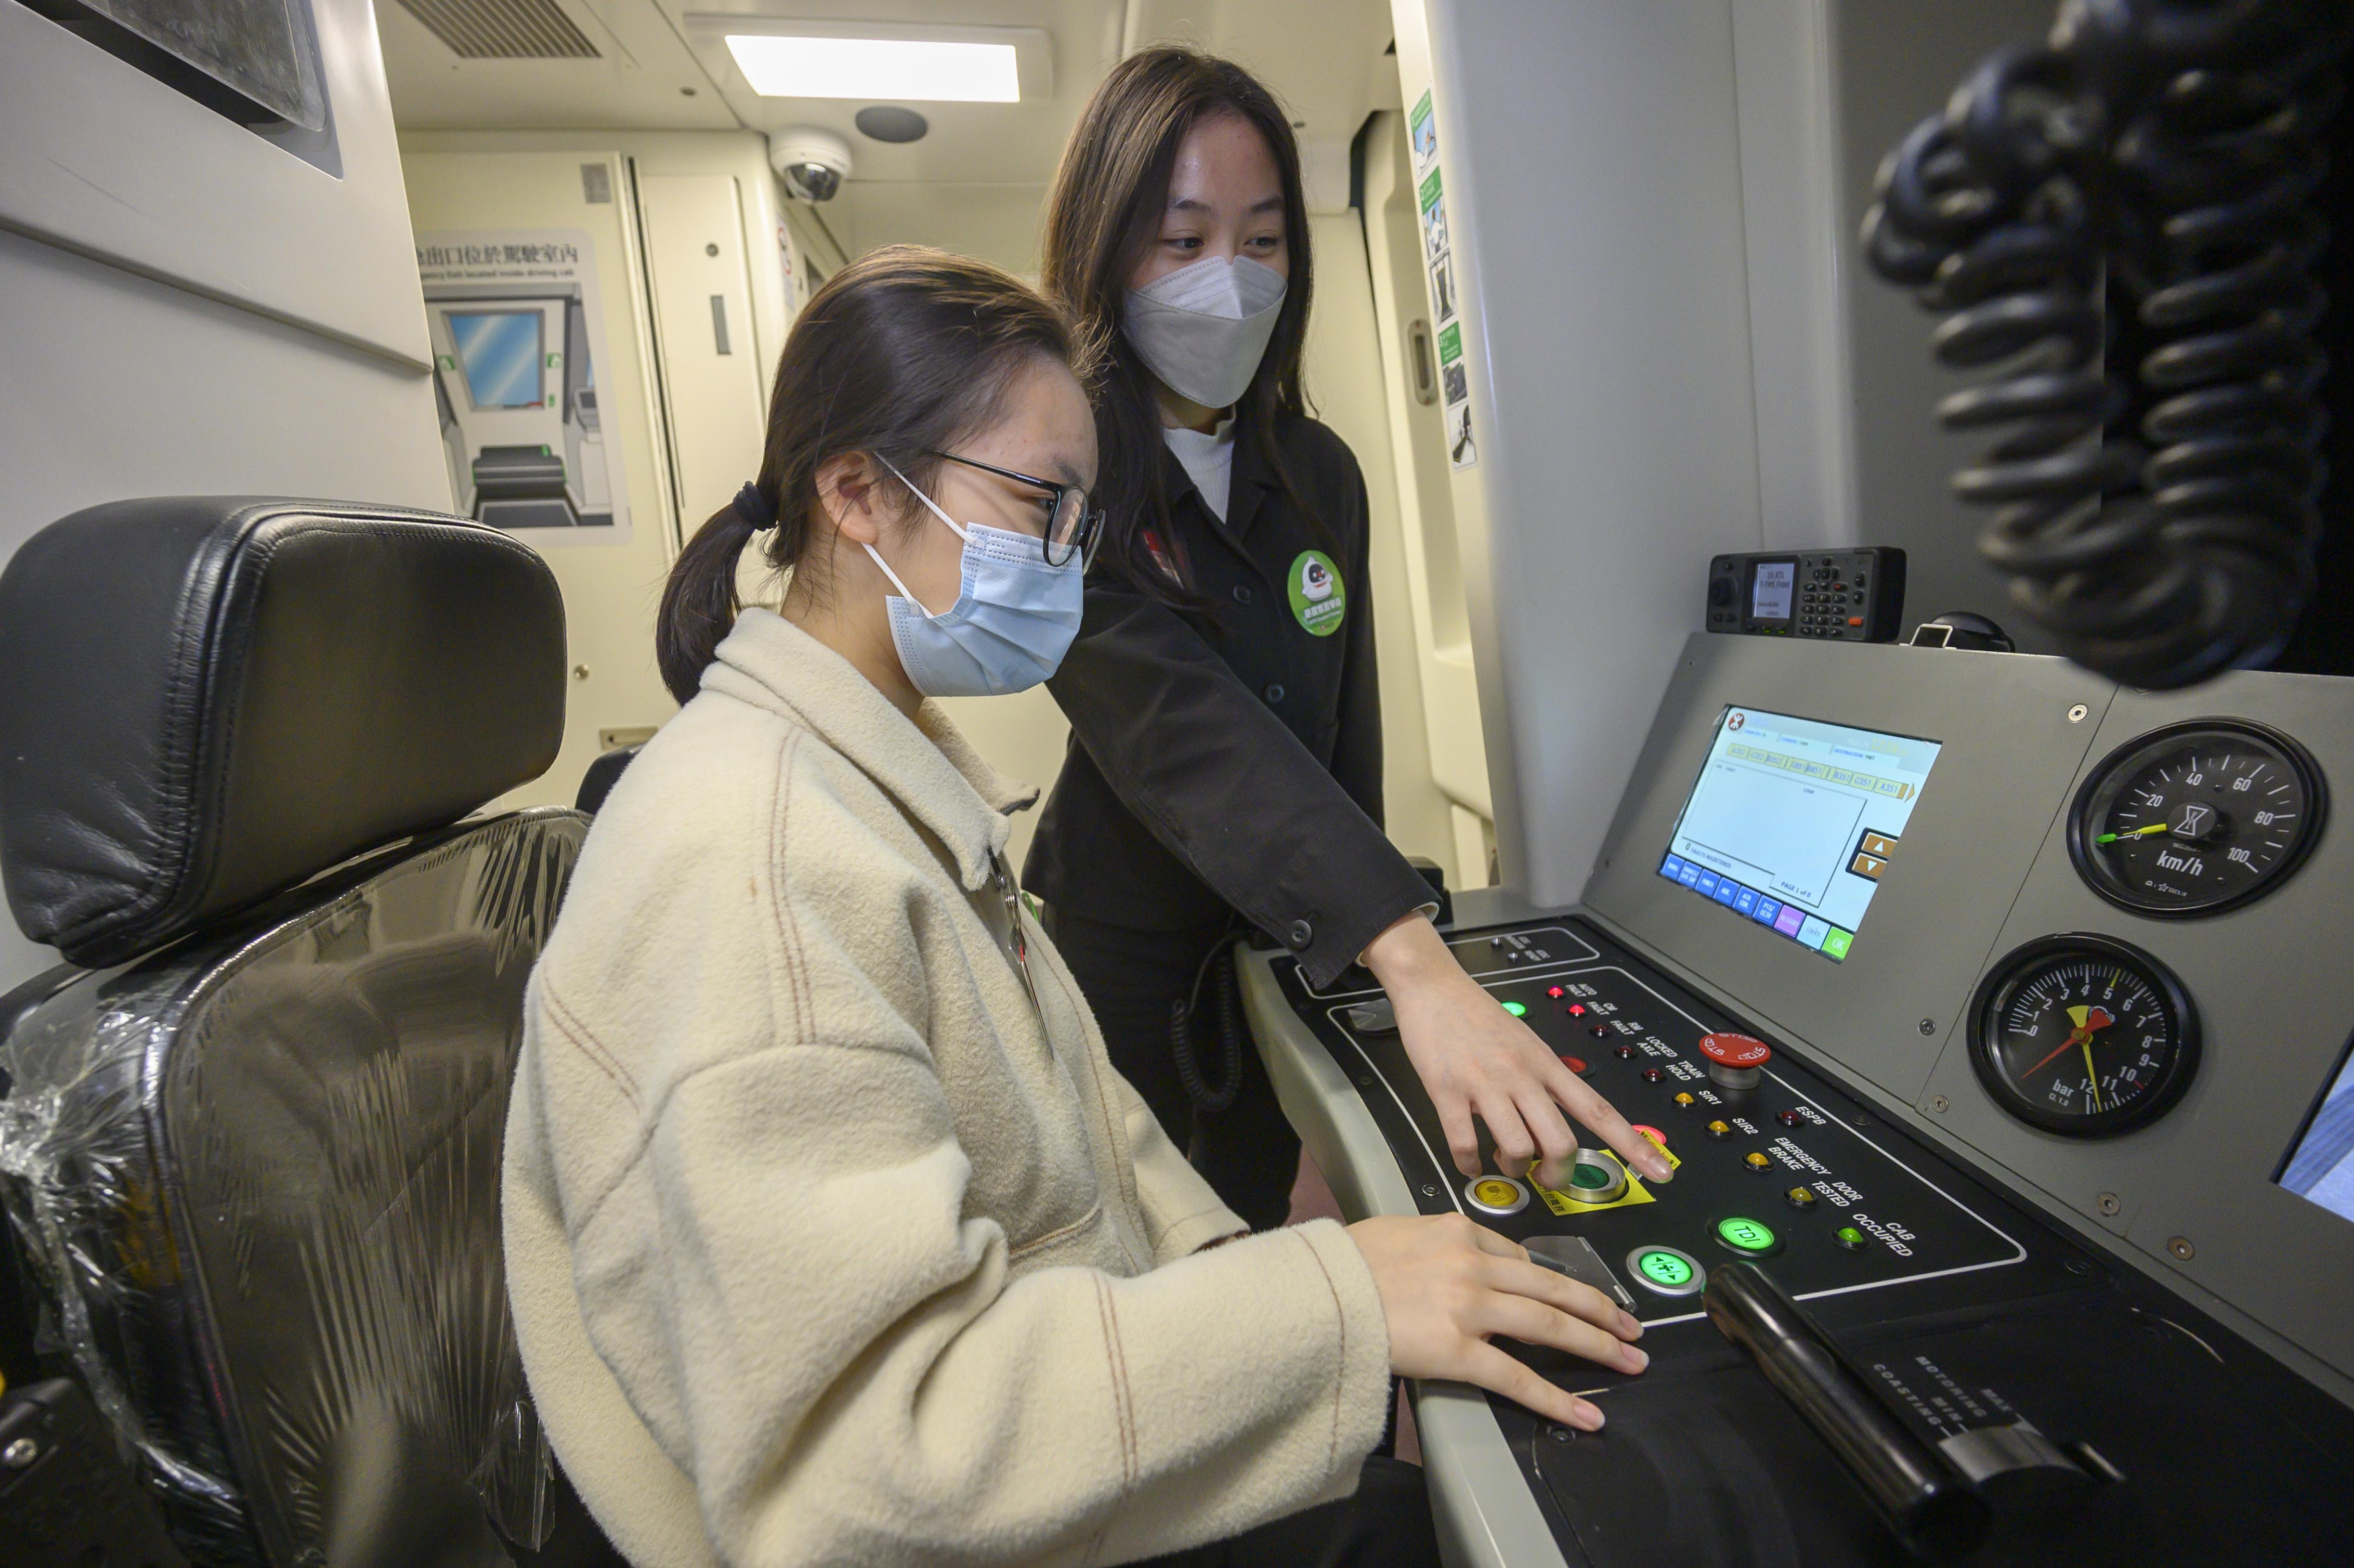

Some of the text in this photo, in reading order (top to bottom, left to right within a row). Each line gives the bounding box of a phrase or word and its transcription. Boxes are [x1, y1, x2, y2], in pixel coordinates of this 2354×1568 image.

[1834, 771, 1850, 781] B351
[1854, 777, 1872, 787] C351
[1880, 782, 1898, 793] A351
[2186, 774, 2203, 786] 40
[2233, 777, 2252, 792] 60
[2146, 794, 2163, 807] 20
[2254, 811, 2274, 826] 80
[2134, 831, 2142, 840] 0
[1691, 848, 1706, 858] FAULTS
[1706, 855, 1732, 869] REGISTERED
[2156, 850, 2204, 876] km/h
[2227, 847, 2251, 864] 100
[1781, 881, 1796, 891] PAGE
[1832, 937, 1846, 951] OK
[1565, 984, 1587, 997] FAULT
[1578, 984, 1597, 996] AUTO
[2060, 988, 2070, 1000] 3
[2081, 984, 2090, 996] 4
[2103, 987, 2113, 1000] 5
[1587, 1001, 1610, 1015] FAULT
[2043, 998, 2052, 1010] 2
[2123, 998, 2133, 1011] 6
[2032, 1011, 2039, 1022] 1
[2136, 1015, 2147, 1028] 7
[1610, 1020, 1635, 1035] FAULT
[1628, 1022, 1644, 1031] RM
[2030, 1025, 2038, 1037] 0
[1637, 1042, 1661, 1056] AXLE
[1645, 1036, 1678, 1057] LOCKED
[2141, 1036, 2152, 1048] 8
[1738, 1047, 1766, 1060] STOP
[2139, 1054, 2150, 1067] 9
[1665, 1064, 1691, 1081] HOLD
[1678, 1060, 1705, 1079] TRAIN
[2120, 1066, 2137, 1082] 10
[2052, 1079, 2074, 1097] bar
[2080, 1078, 2094, 1094] 12
[2102, 1075, 2118, 1091] 11
[1698, 1090, 1722, 1105] SIR1
[1795, 1105, 1827, 1126] ESPB
[1732, 1117, 1758, 1135] SIR2
[1768, 1146, 1804, 1171] BRAKE
[1774, 1136, 1832, 1177] EMERGENCY
[1812, 1181, 1850, 1207] TESTED
[1832, 1181, 1864, 1201] DOOR
[1734, 1225, 1761, 1242] TDI
[1852, 1213, 1913, 1257] OCCUPIED
[1886, 1222, 1916, 1241] CAB
[1915, 1356, 1987, 1417] MOTORING
[1873, 1364, 1942, 1425] COASTING
[1932, 1396, 1963, 1422] MIN
